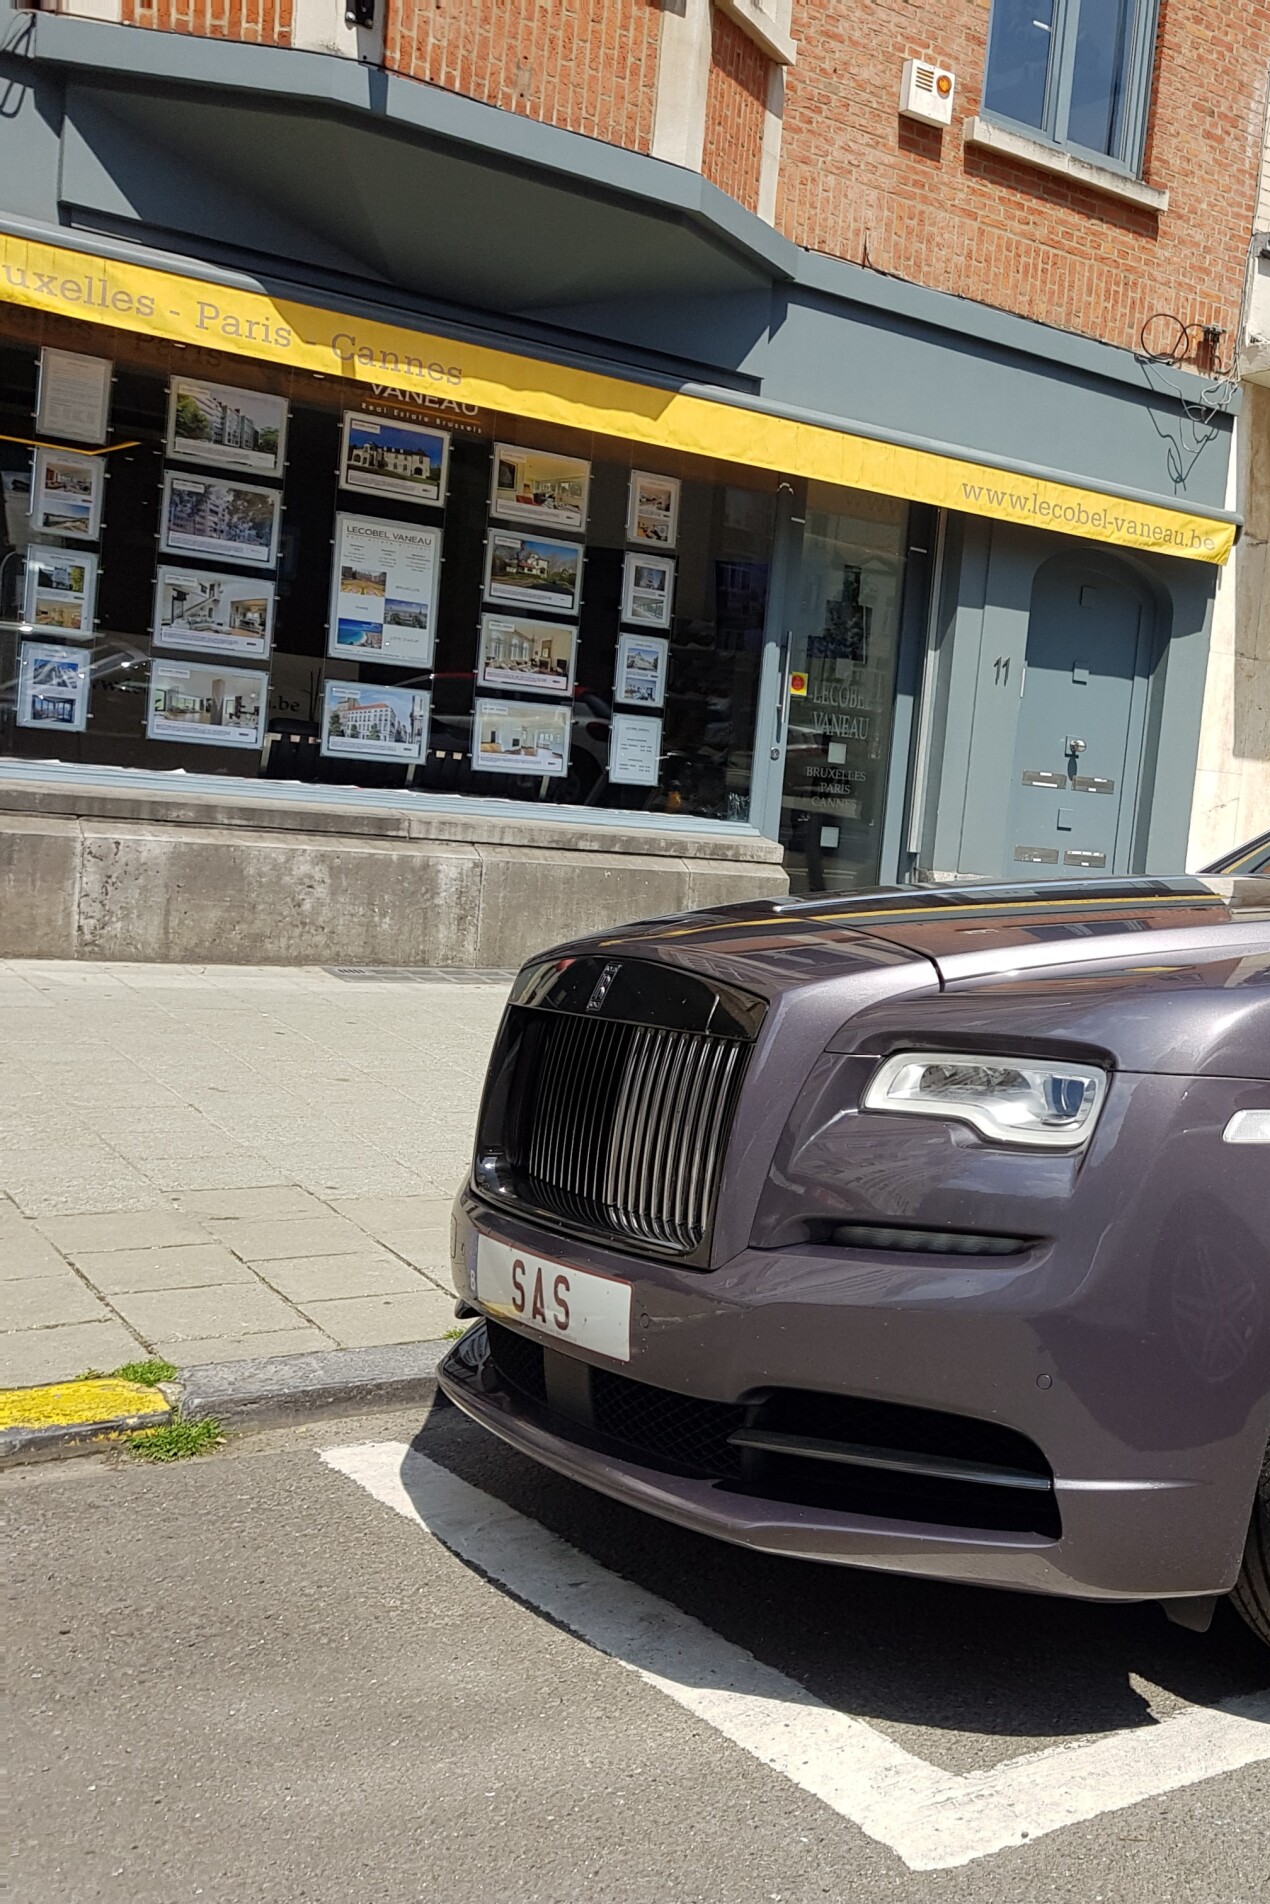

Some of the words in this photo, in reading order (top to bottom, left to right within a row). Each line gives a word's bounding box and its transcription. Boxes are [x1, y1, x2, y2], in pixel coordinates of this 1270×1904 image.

[195, 301, 292, 348] Paris
[331, 332, 463, 386] Cannes
[371, 383, 479, 416] VANEAU
[962, 482, 1216, 551] www.lecobel-vaneau.be
[346, 525, 390, 540] LECOBEL
[392, 532, 432, 546] VANEAU
[993, 655, 1011, 687] 11
[812, 711, 870, 740] VANEAU
[806, 766, 866, 782] BRUXELLES
[820, 782, 851, 795] PARIS
[811, 796, 857, 810] CANNES
[512, 1259, 571, 1332] SAS
